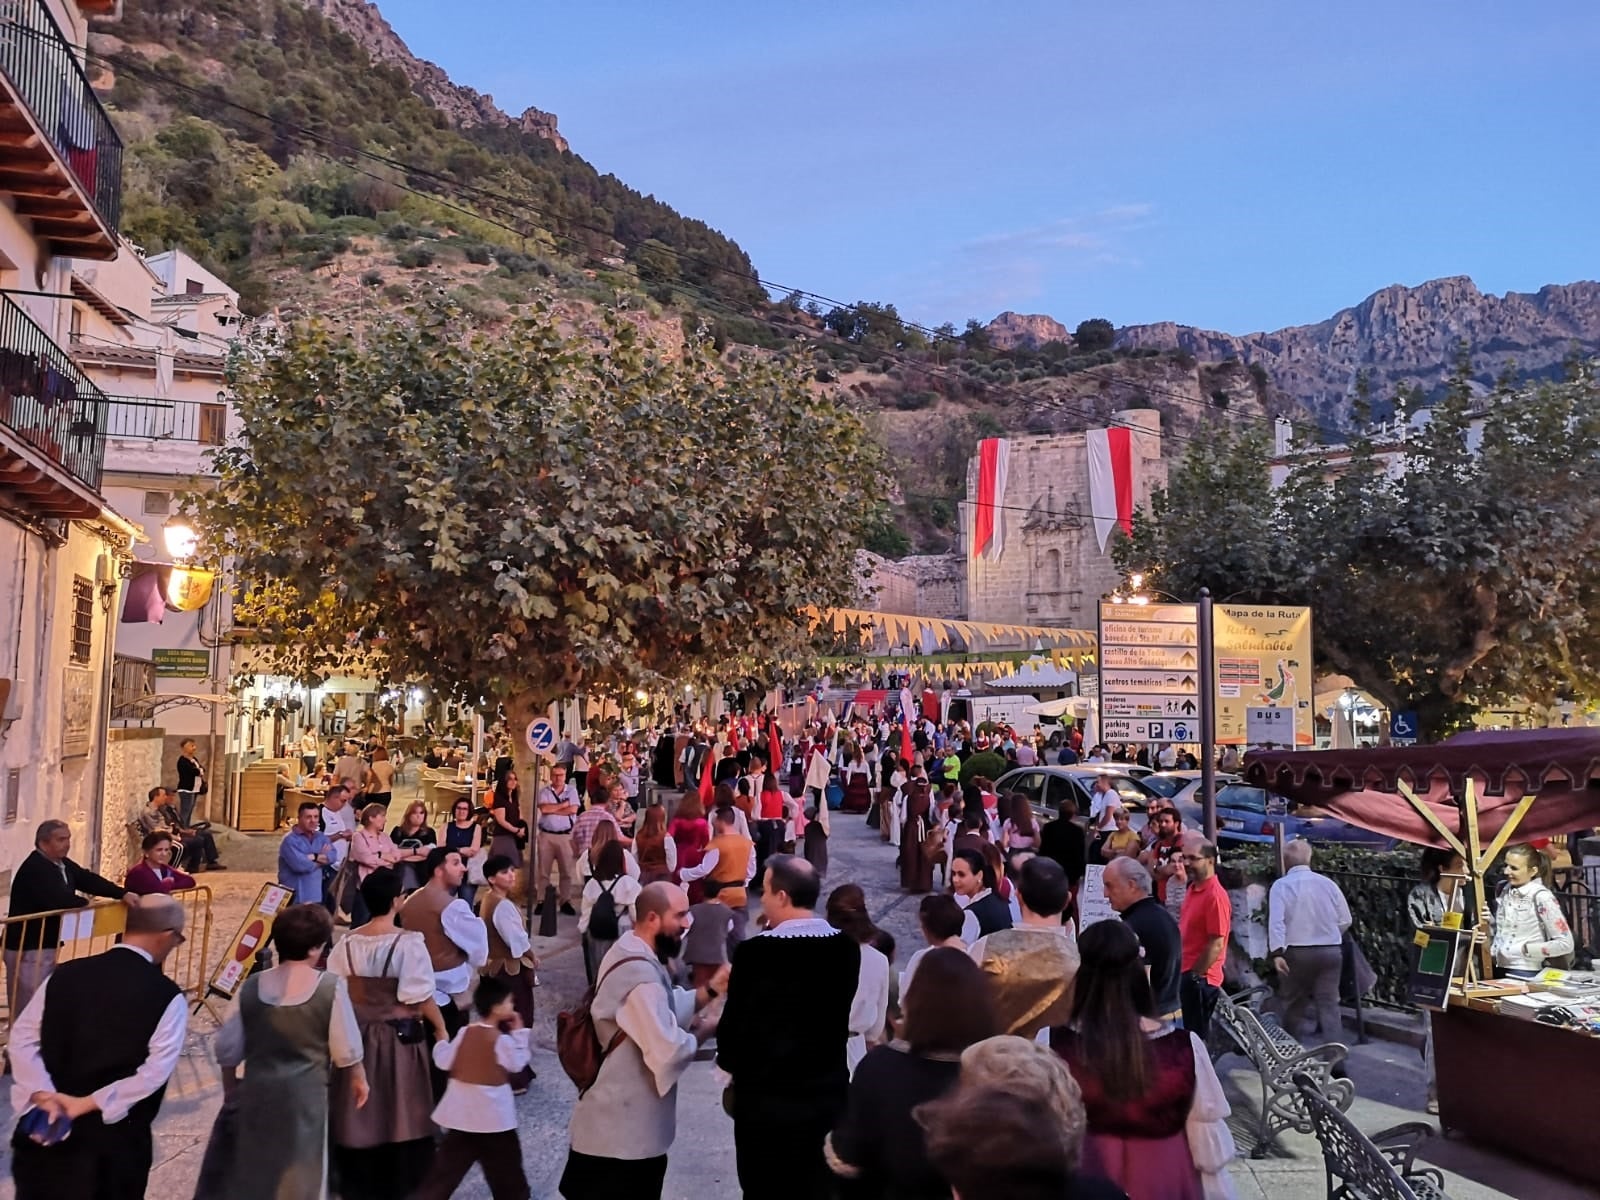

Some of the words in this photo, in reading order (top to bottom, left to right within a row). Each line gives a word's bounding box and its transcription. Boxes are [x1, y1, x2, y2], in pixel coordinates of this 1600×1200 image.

[1223, 608, 1249, 618] Mapa
[1251, 610, 1264, 618] de
[1266, 610, 1275, 618] la
[1278, 610, 1301, 619] Ruta
[1104, 624, 1127, 633] oficina
[1127, 625, 1137, 633] de
[1137, 625, 1163, 634] turismo
[1226, 624, 1257, 636] Ruta
[1129, 634, 1138, 642] de
[1226, 639, 1294, 651] Saludable
[1104, 647, 1128, 656] castillo
[1129, 648, 1138, 656] de
[1138, 649, 1146, 657] la
[1123, 657, 1138, 665] Alto
[1104, 678, 1129, 686] centros
[1130, 678, 1162, 686] temáticos
[1105, 720, 1130, 729] parking
[1105, 730, 1130, 739] público
